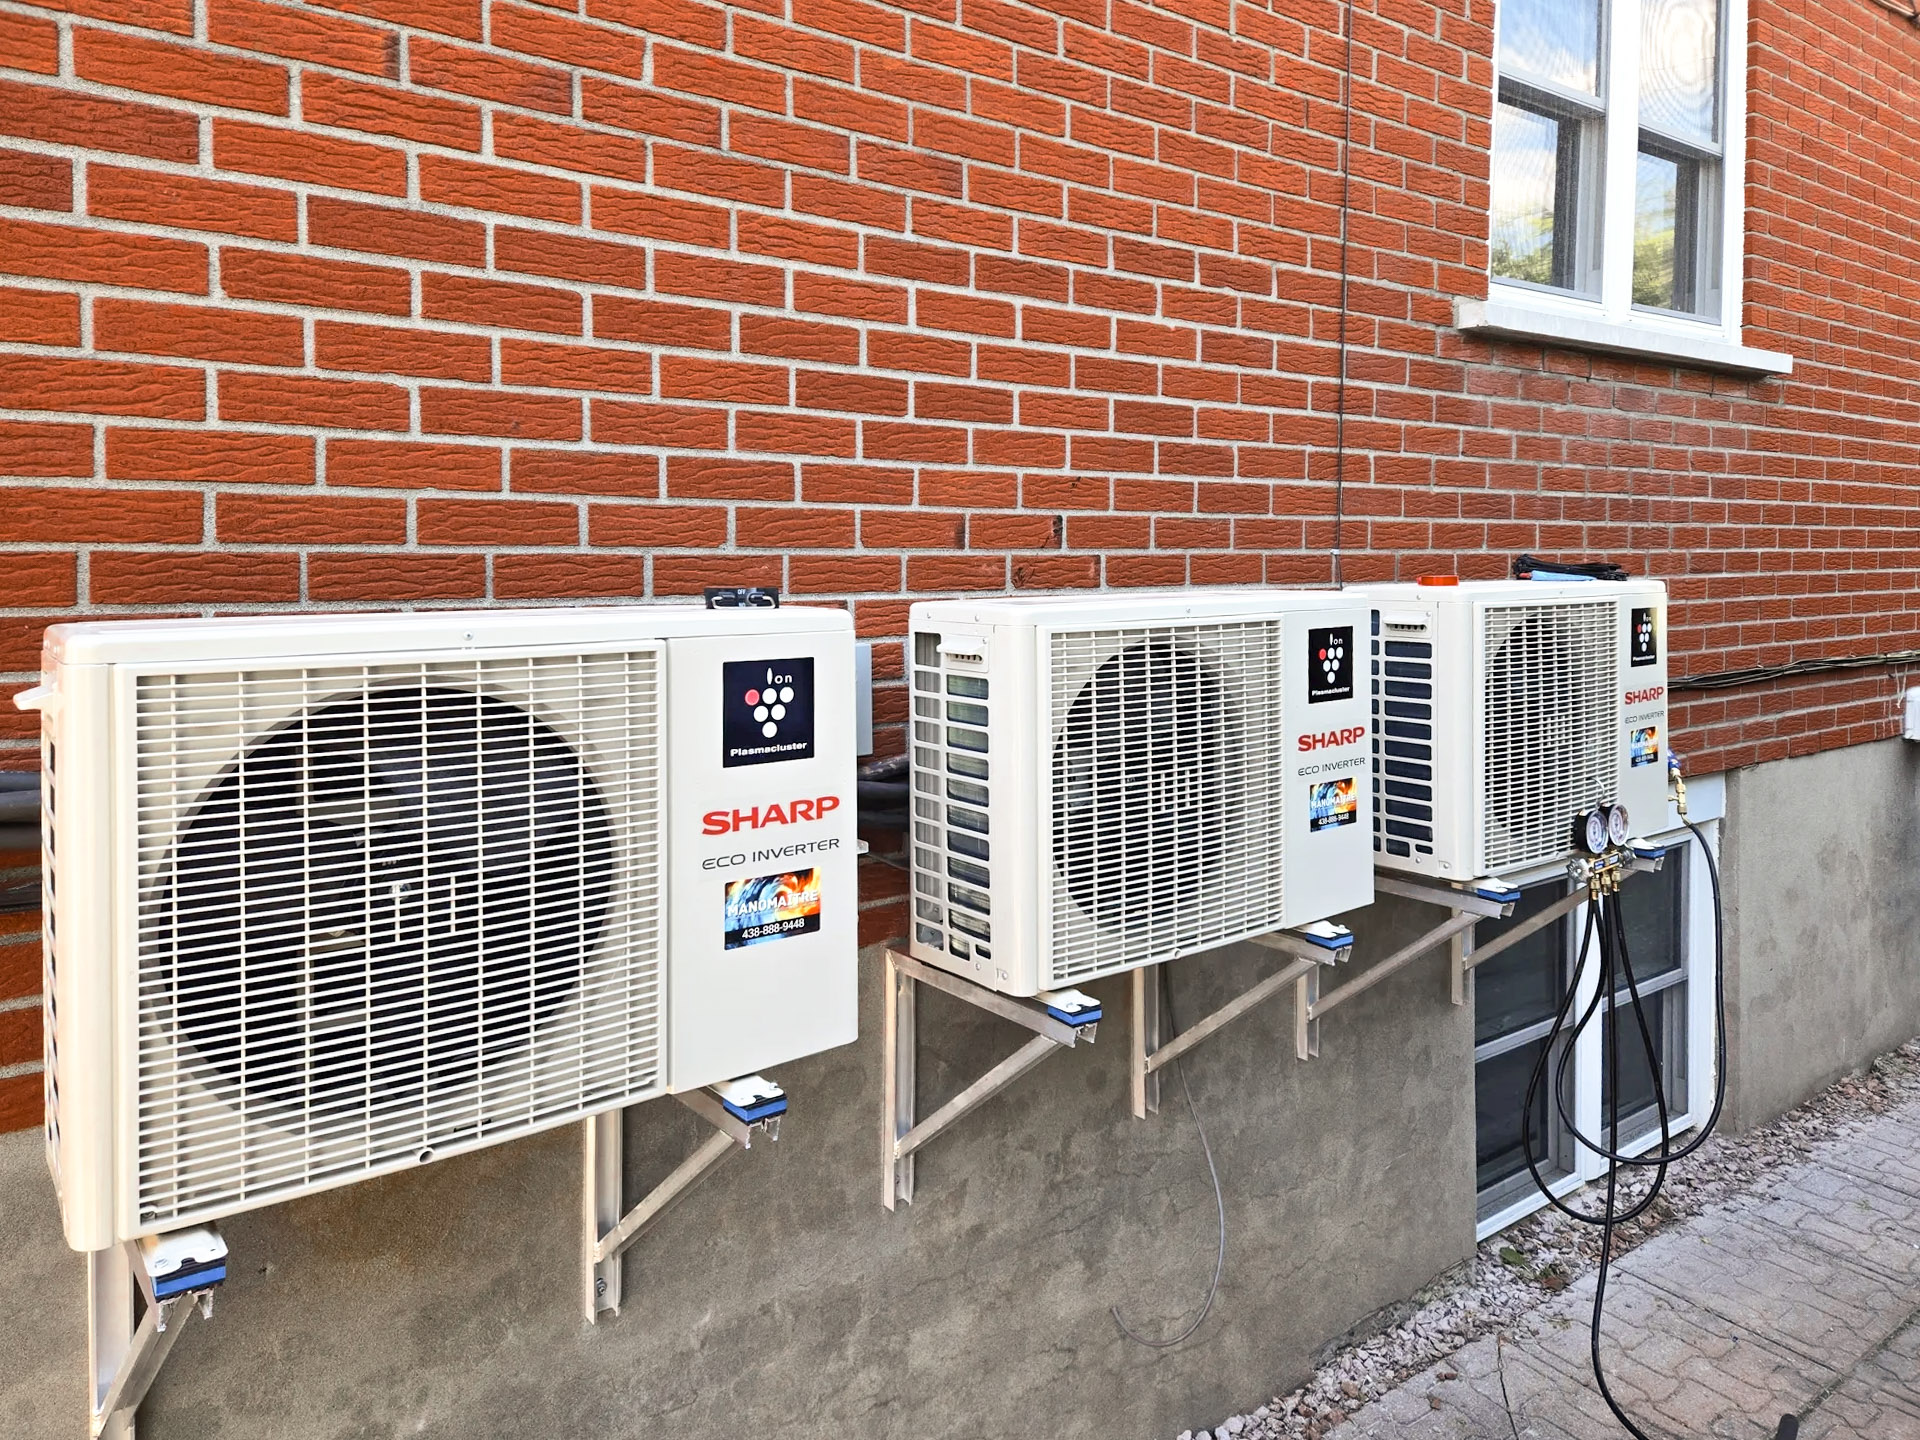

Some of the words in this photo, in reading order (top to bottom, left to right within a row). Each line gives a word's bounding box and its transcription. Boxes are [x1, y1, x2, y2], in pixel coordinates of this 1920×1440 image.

[766, 667, 793, 685] Ion
[1624, 686, 1664, 705] SHARP
[1625, 715, 1638, 724] ECO
[1638, 710, 1665, 721] INVERTER
[1298, 726, 1365, 752] SHARP
[730, 742, 808, 757] Plasmacluster
[1297, 765, 1320, 776] ECO
[1322, 757, 1366, 772] INVERTER
[701, 796, 840, 836] SHARP
[702, 853, 746, 870] ECO
[752, 838, 840, 862] INVERTER
[742, 917, 805, 939] 438-888-9448
